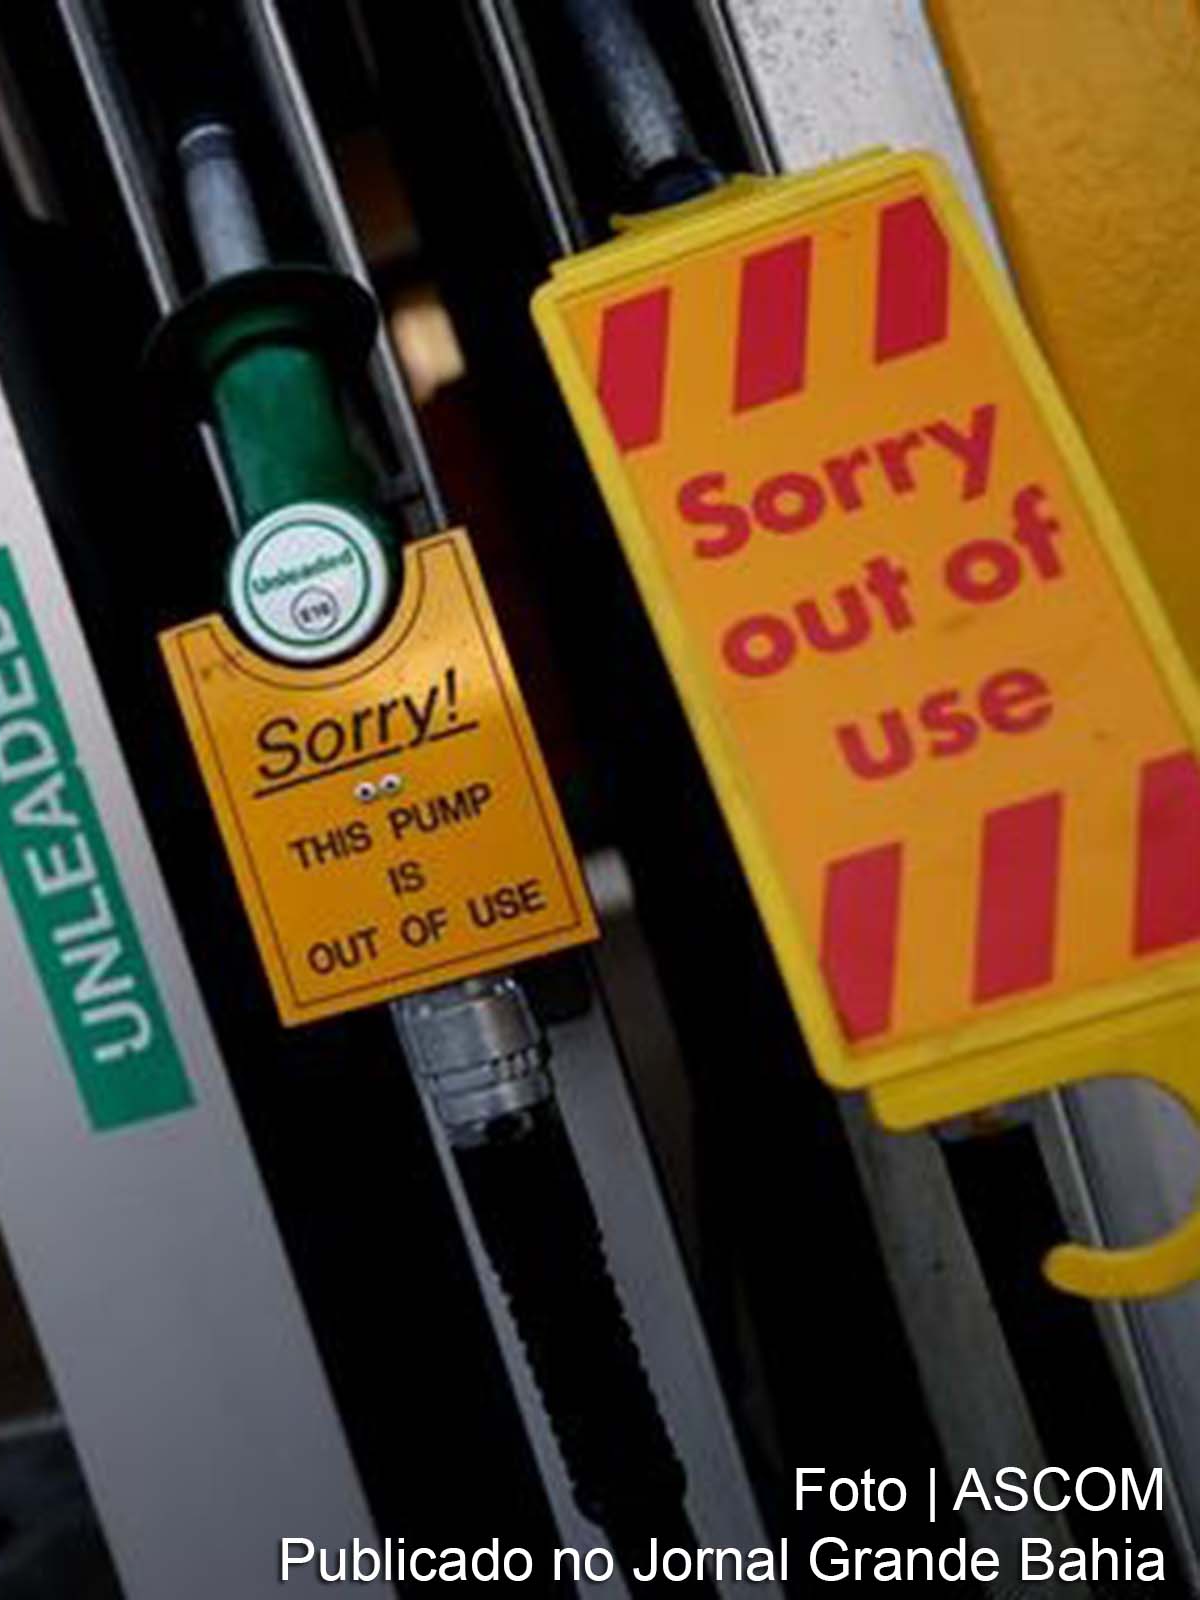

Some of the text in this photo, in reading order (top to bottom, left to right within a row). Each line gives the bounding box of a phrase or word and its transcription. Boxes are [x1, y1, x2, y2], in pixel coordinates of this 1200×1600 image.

[675, 402, 997, 560] Sorry
[722, 484, 1062, 677] out of
[256, 668, 459, 782] Sorry!
[835, 669, 1053, 781] use
[289, 783, 491, 869] THIS PUMP
[387, 861, 426, 896] IS
[307, 879, 547, 976] OUT OF USE
